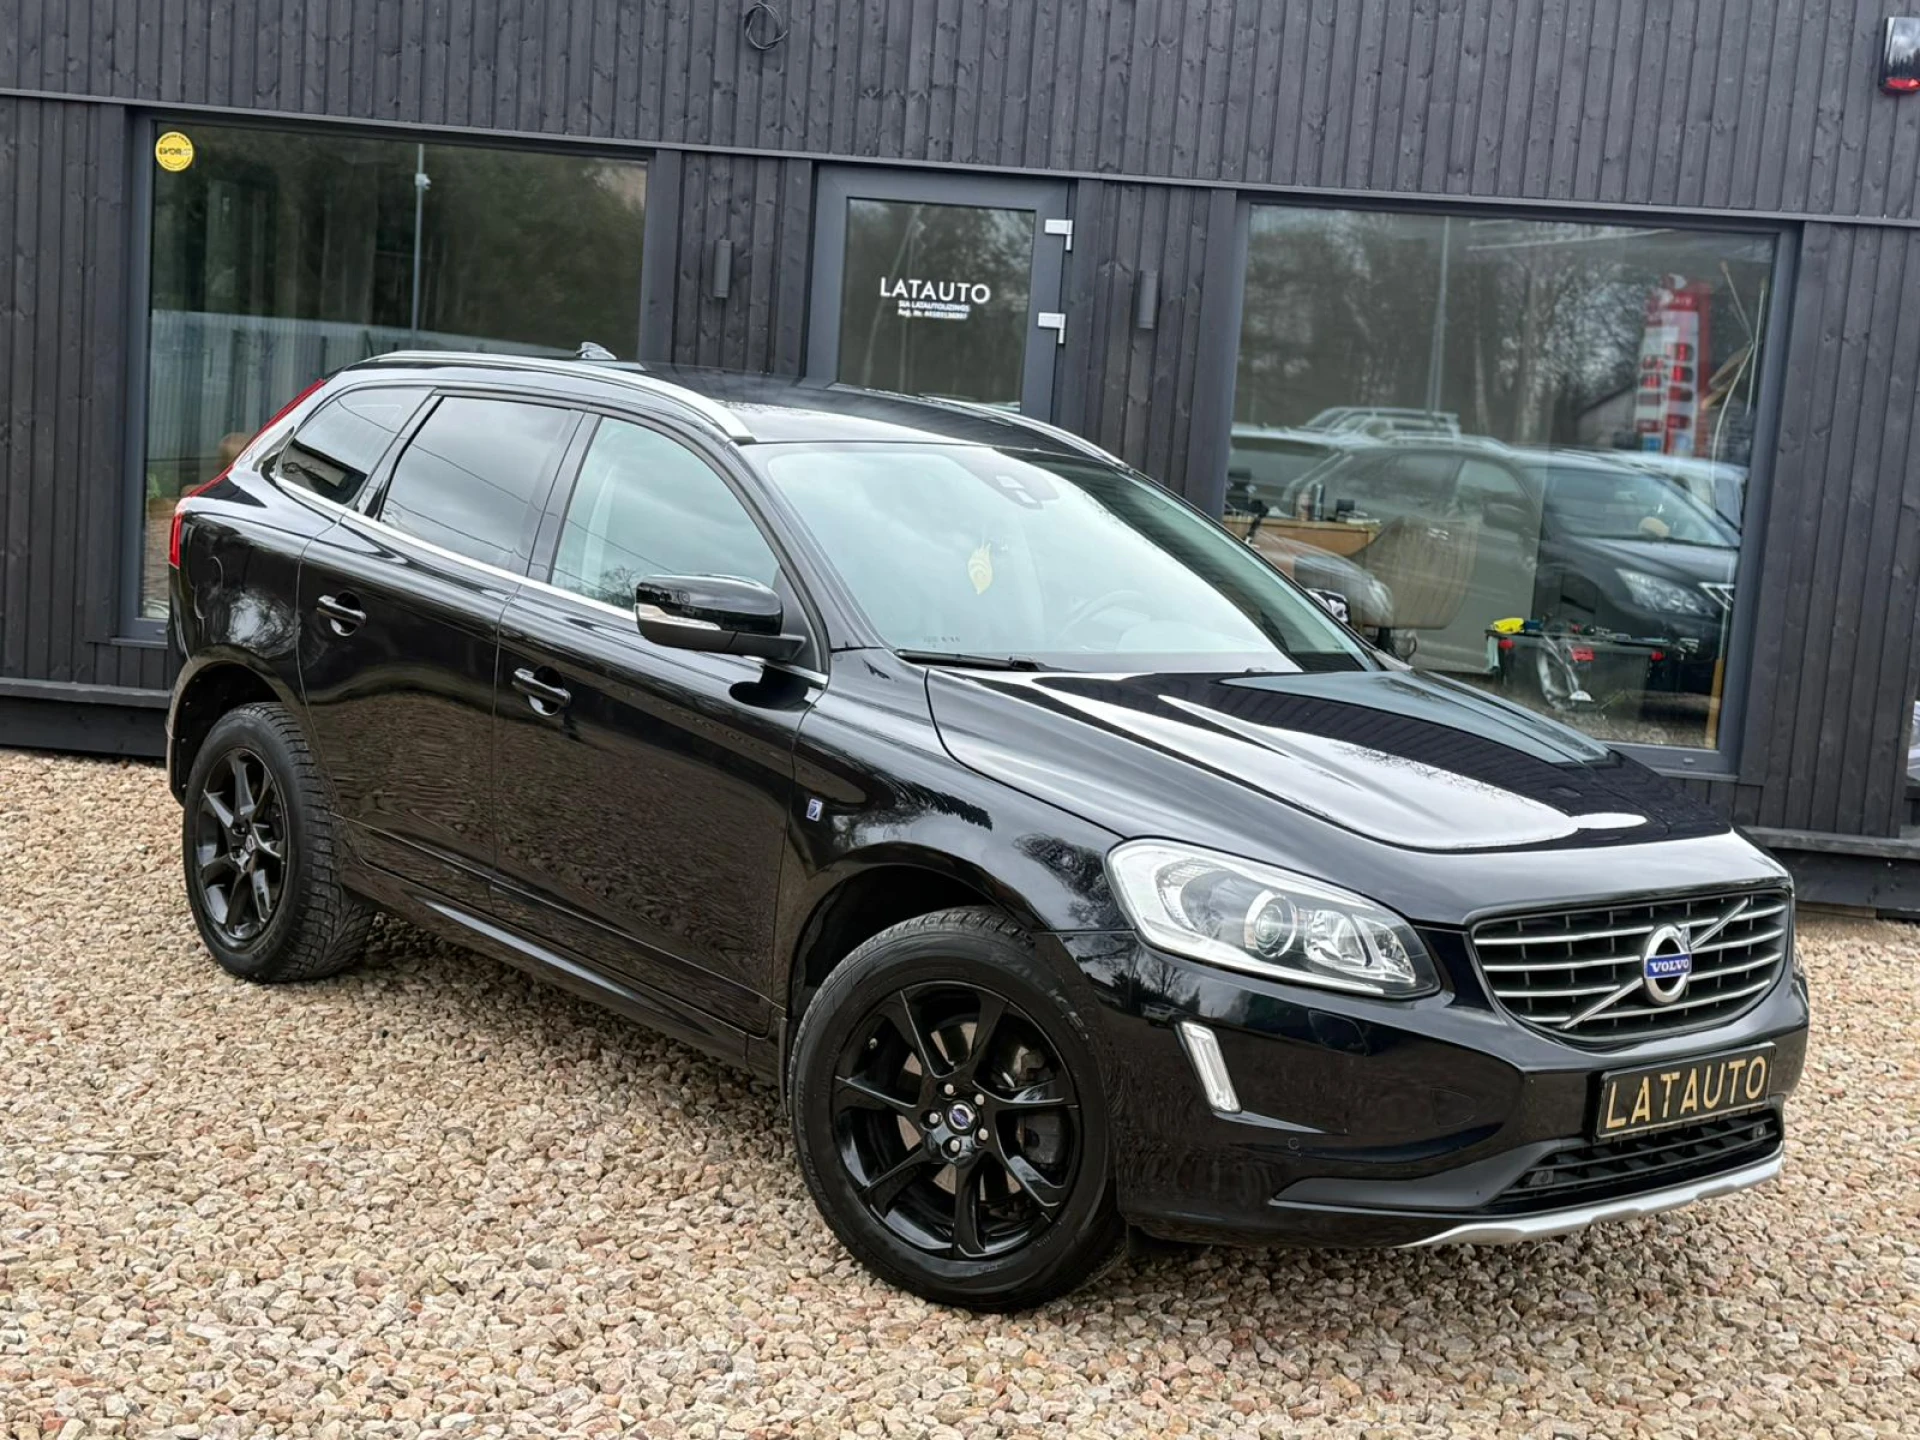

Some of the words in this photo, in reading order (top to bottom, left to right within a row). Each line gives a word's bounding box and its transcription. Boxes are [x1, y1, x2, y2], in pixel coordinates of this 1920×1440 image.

[880, 276, 991, 304] LATAUTO
[1649, 958, 1689, 973] VOLVO
[1605, 1055, 1767, 1129] LATAUTO
